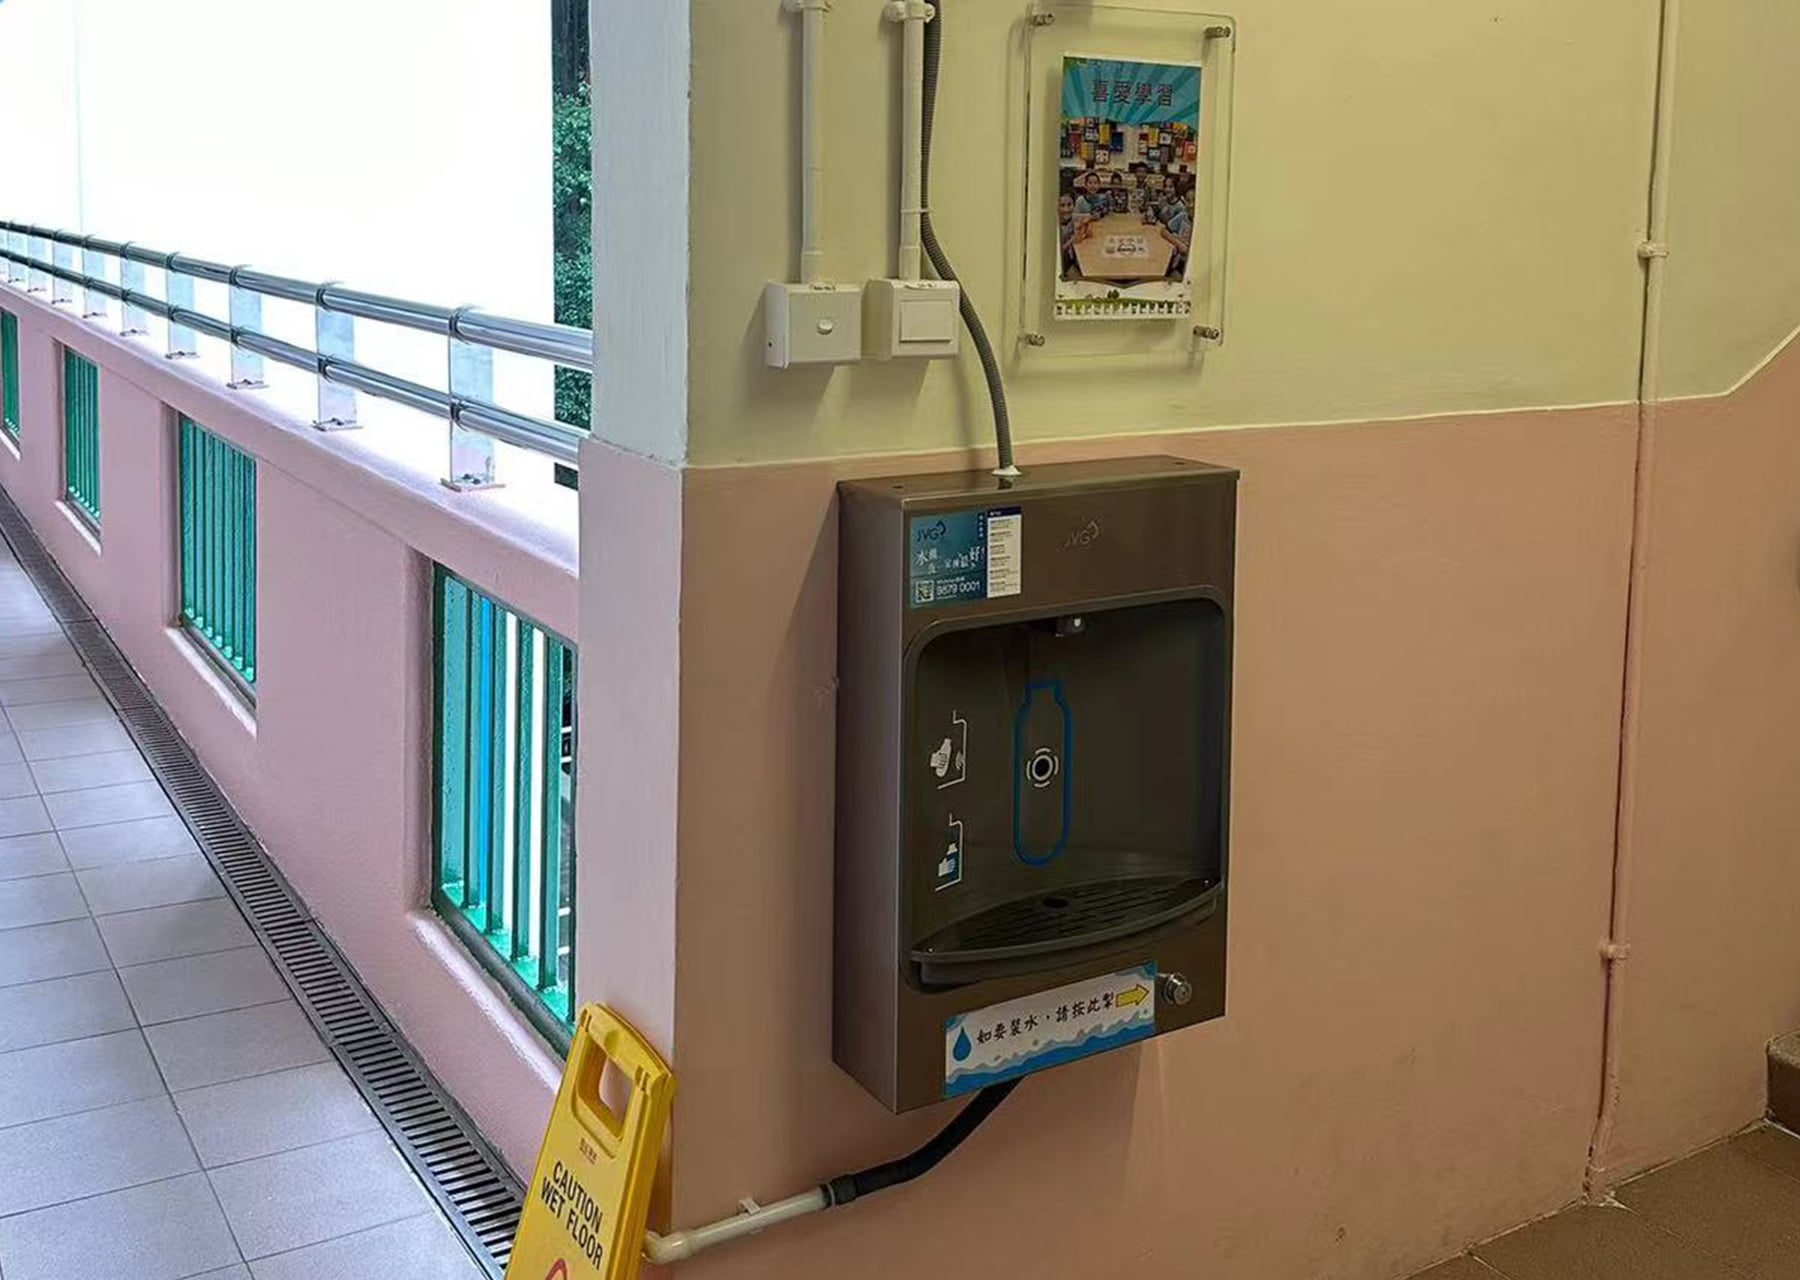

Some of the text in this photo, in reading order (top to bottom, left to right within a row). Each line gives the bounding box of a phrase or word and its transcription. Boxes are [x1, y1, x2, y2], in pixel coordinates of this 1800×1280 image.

[1091, 80, 1173, 106] 喜愛學習
[960, 581, 980, 593] 0001
[553, 1160, 603, 1234] CAUTION
[541, 1176, 603, 1271] WET FLOOR
